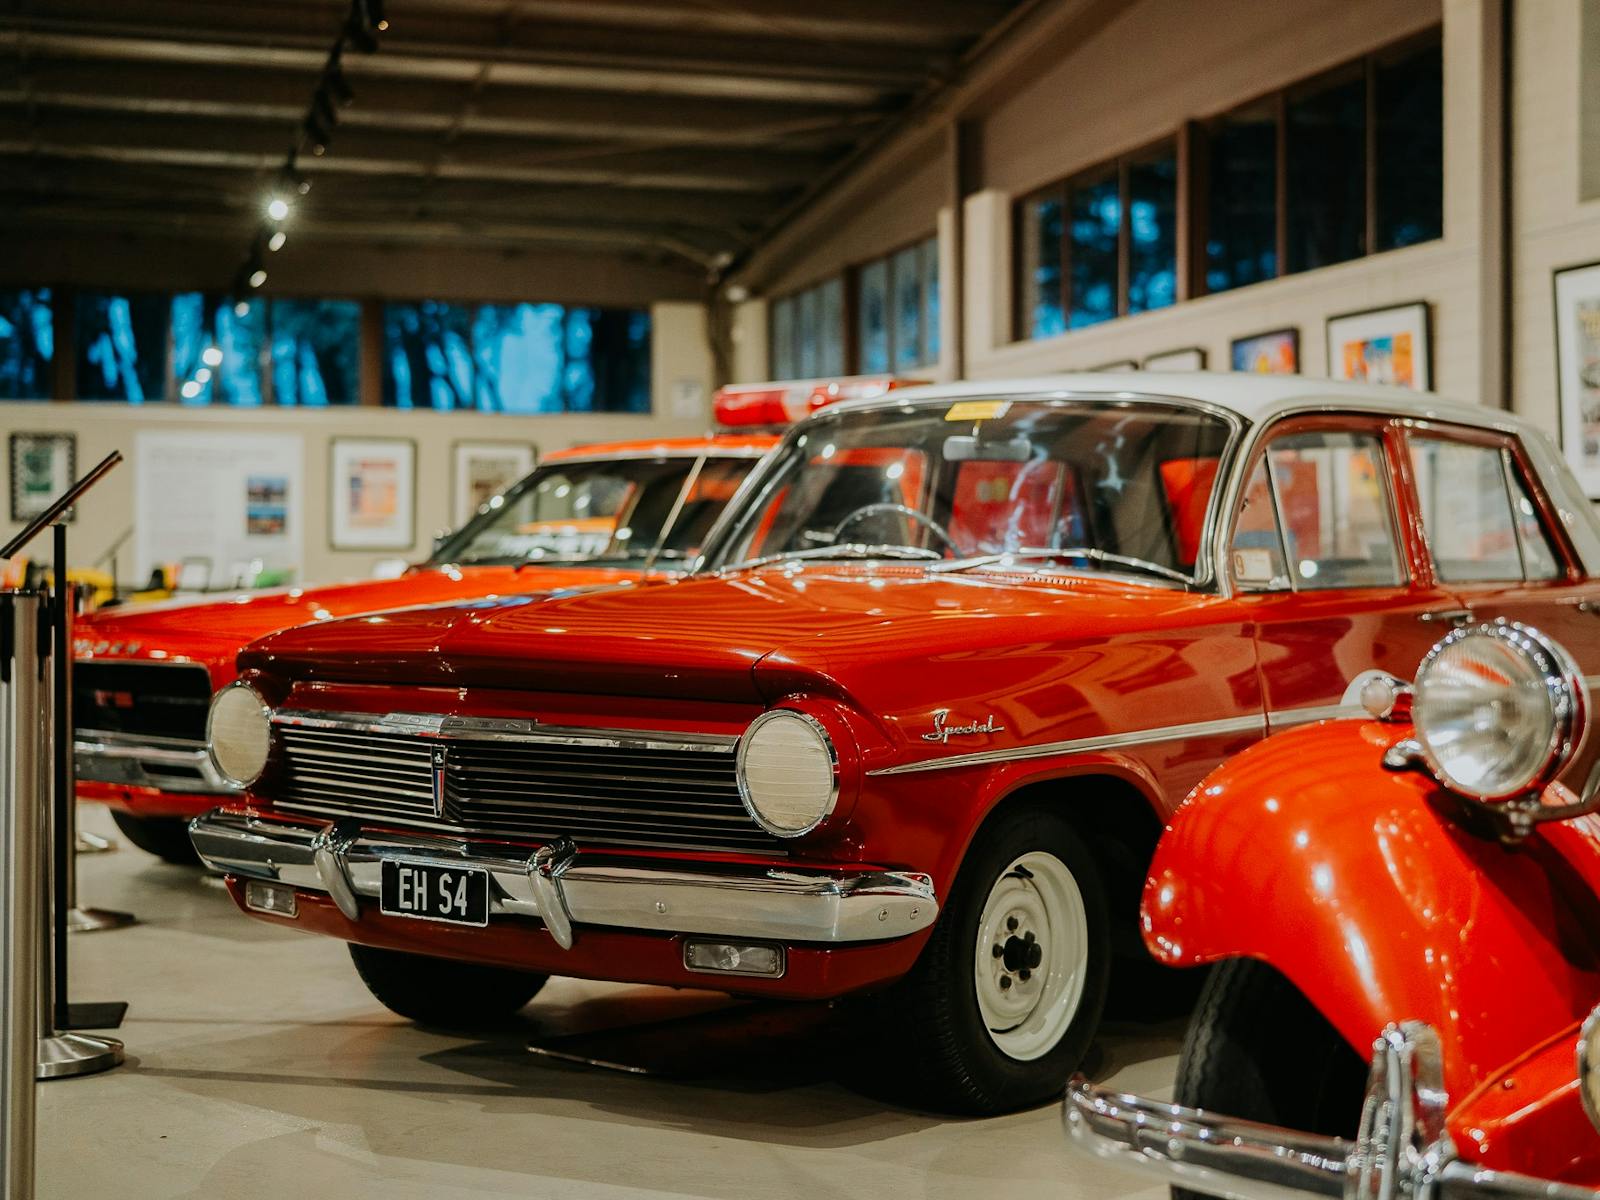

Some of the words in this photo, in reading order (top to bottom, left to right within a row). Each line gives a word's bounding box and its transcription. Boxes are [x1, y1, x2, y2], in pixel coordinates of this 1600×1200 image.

[921, 708, 1005, 744] Special
[398, 867, 428, 911] EH
[438, 872, 468, 917] S4
